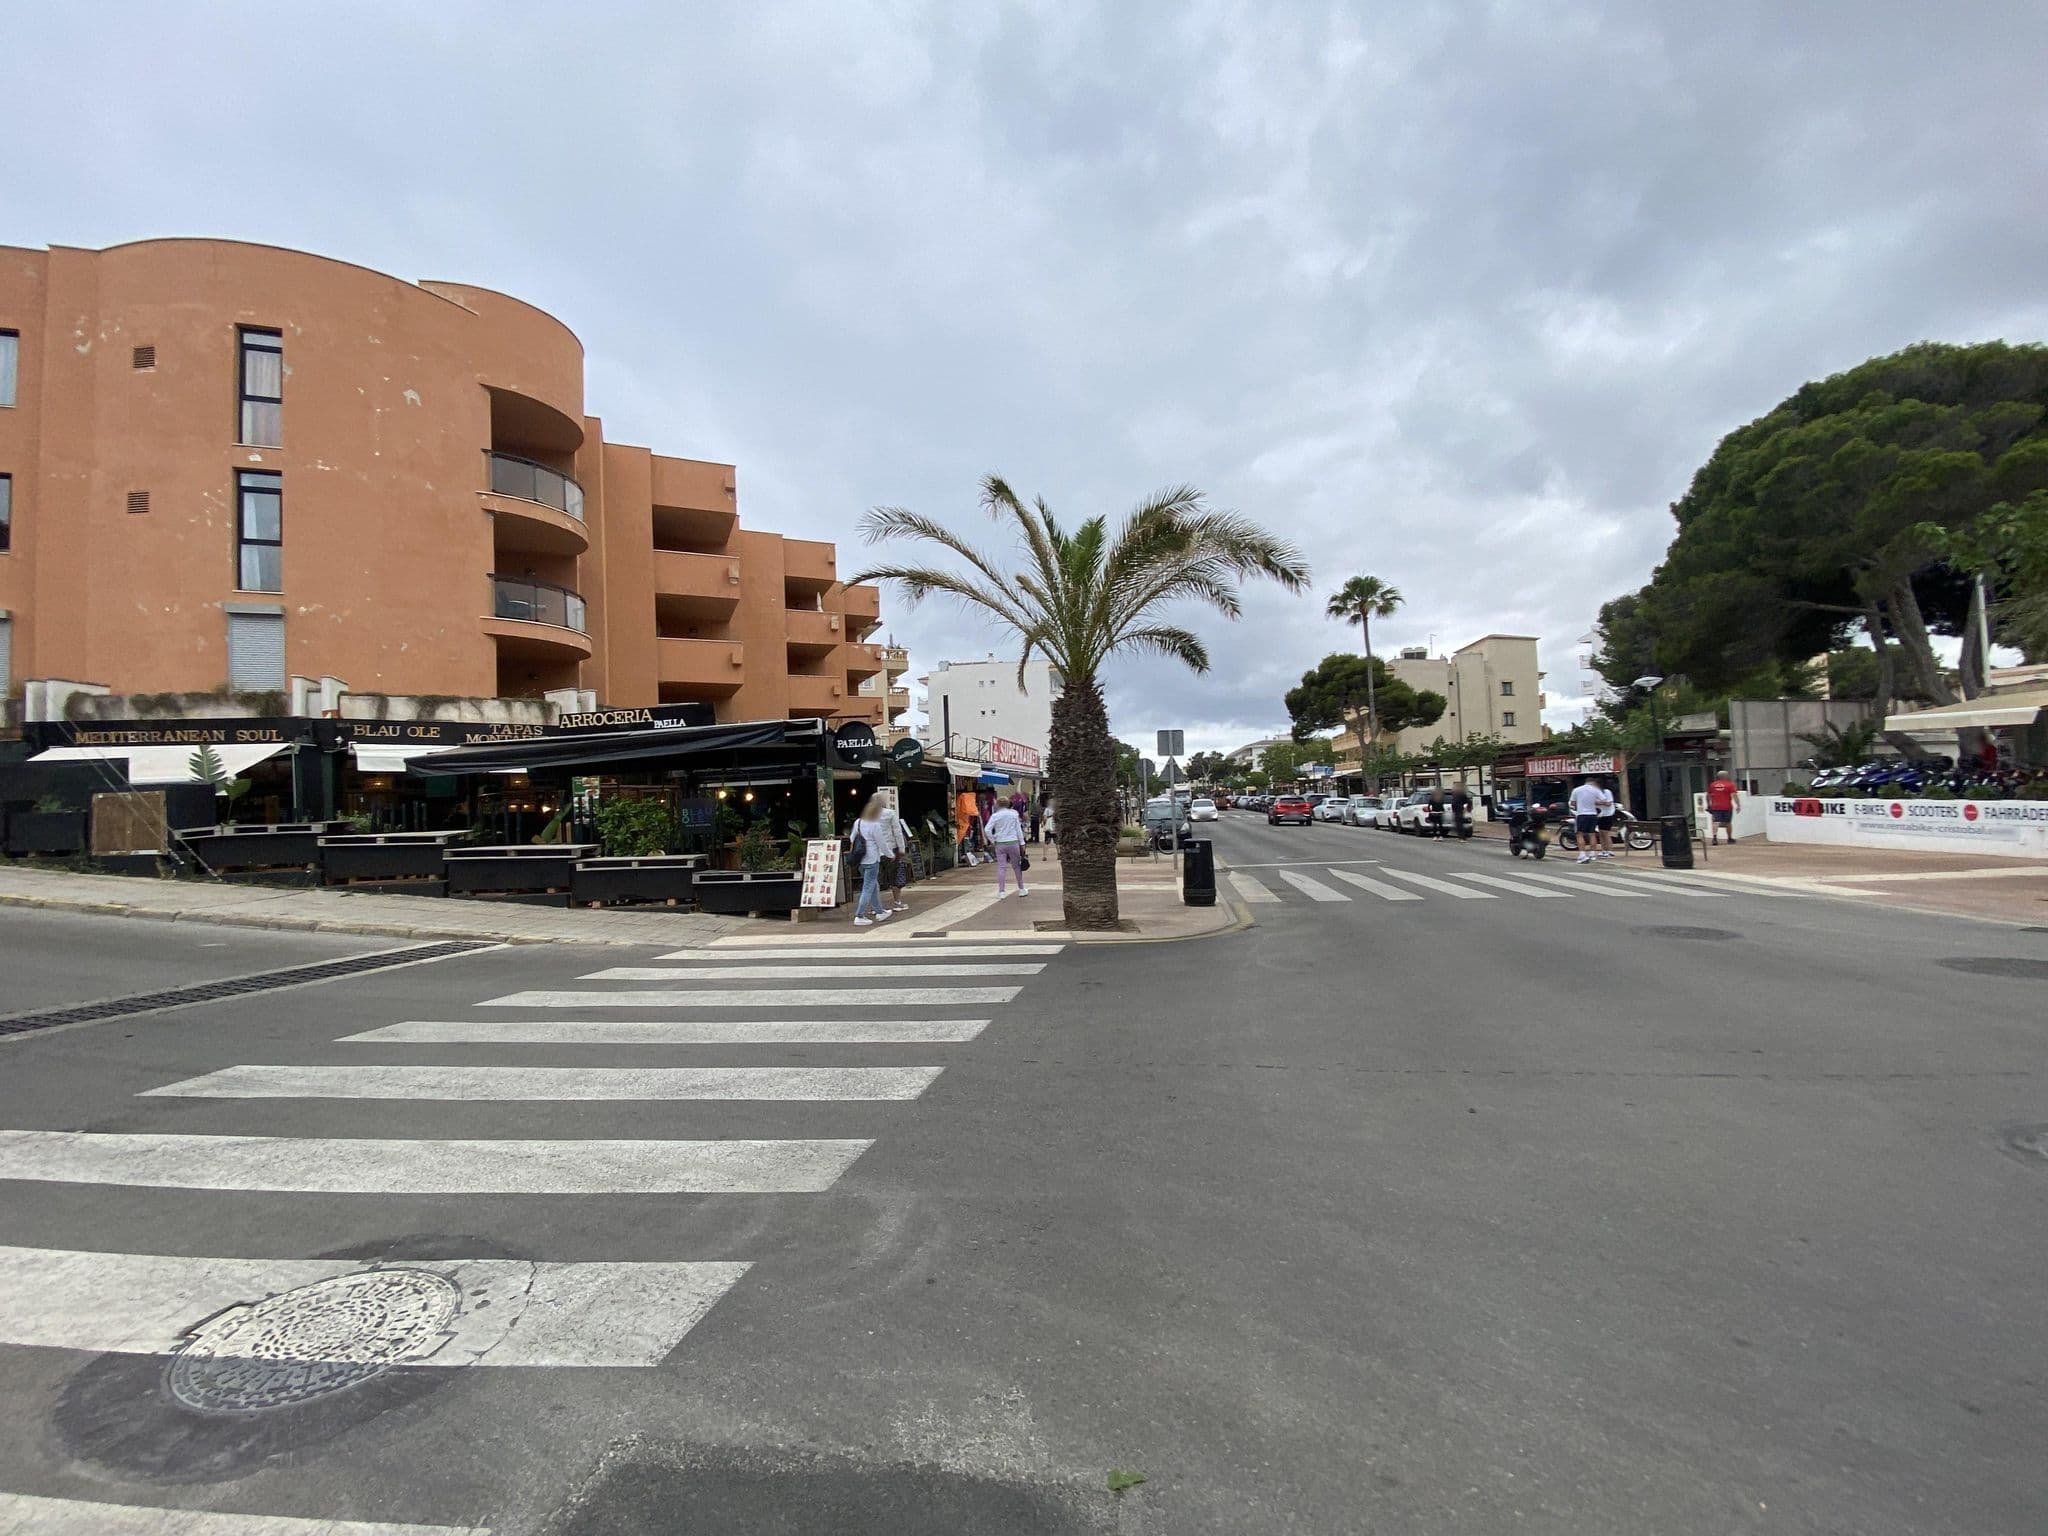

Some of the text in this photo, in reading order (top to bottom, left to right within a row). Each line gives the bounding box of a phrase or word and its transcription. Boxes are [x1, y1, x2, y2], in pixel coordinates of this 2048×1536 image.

[560, 709, 653, 728] ARROCERIA
[654, 719, 687, 729] PAELLA
[75, 729, 284, 744] MEDITERRANEAN SOUL
[353, 725, 441, 738] BLAU OLE
[489, 724, 544, 736] TAPAS
[837, 738, 873, 749] PAELLA
[999, 740, 1039, 767] SUPERMARKET
[1774, 801, 1802, 814] RENT
[1806, 802, 1815, 814] A
[1818, 803, 1846, 815] BIKE
[1908, 805, 1958, 818] SCOOTERS
